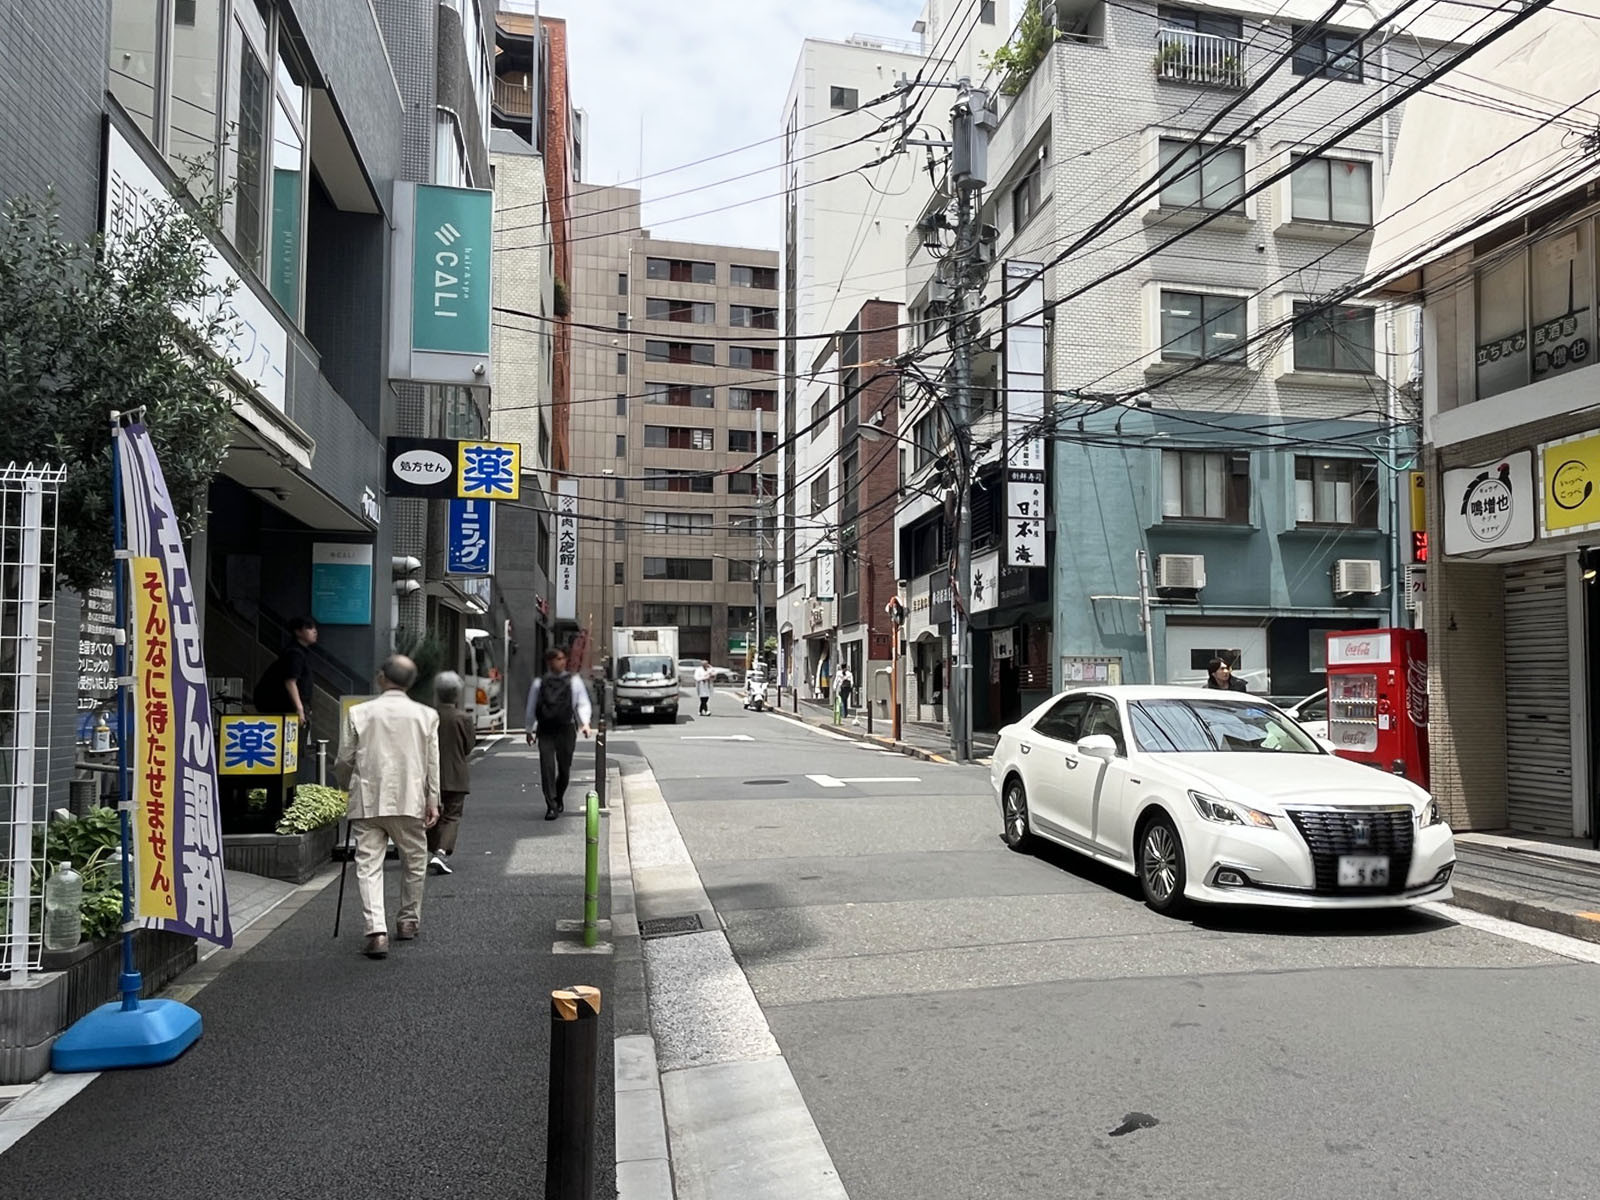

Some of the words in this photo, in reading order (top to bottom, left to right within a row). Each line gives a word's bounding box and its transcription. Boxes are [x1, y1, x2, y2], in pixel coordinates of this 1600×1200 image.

[434, 251, 459, 317] CALI
[1478, 336, 1526, 364] 立ち飲み
[1535, 318, 1576, 345] 居酒屋
[400, 461, 446, 473] 処方せん
[464, 446, 514, 494] 薬
[142, 571, 173, 906] そんなに待たせません。
[225, 721, 277, 768] 薬
